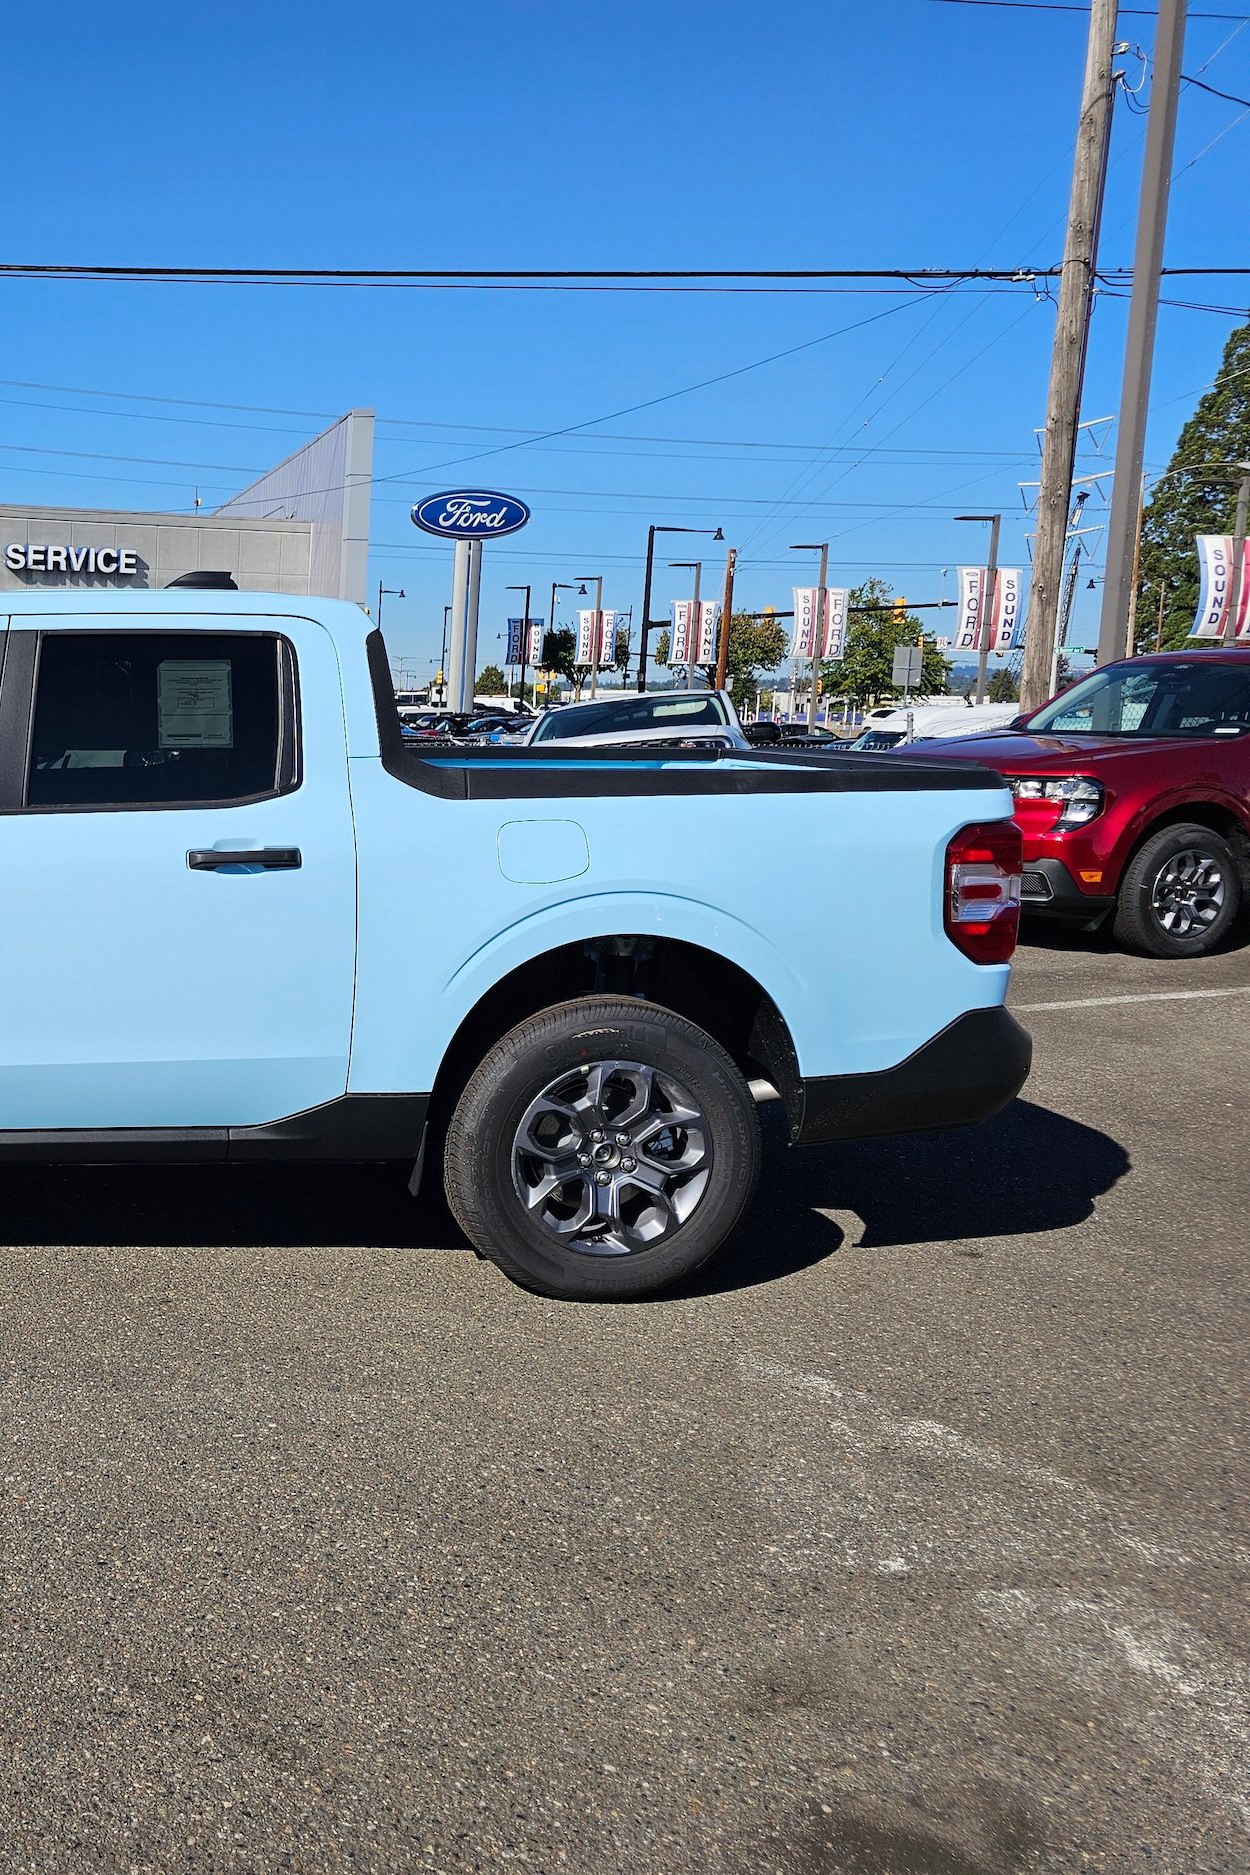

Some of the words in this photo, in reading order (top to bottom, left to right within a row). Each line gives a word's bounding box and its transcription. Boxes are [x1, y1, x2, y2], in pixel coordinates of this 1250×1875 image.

[438, 498, 509, 528] Ford
[4, 543, 137, 574] SERVICE
[1001, 579, 1016, 641] SOUND
[1208, 549, 1226, 624] SOUND
[582, 617, 590, 657] SOUND
[675, 610, 686, 660] FORD
[703, 608, 713, 656] SOUND
[800, 595, 810, 650] SOUND
[829, 598, 842, 656] FORD
[960, 580, 979, 647] FORD
[510, 624, 520, 662] FORD
[603, 619, 614, 662] FORD
